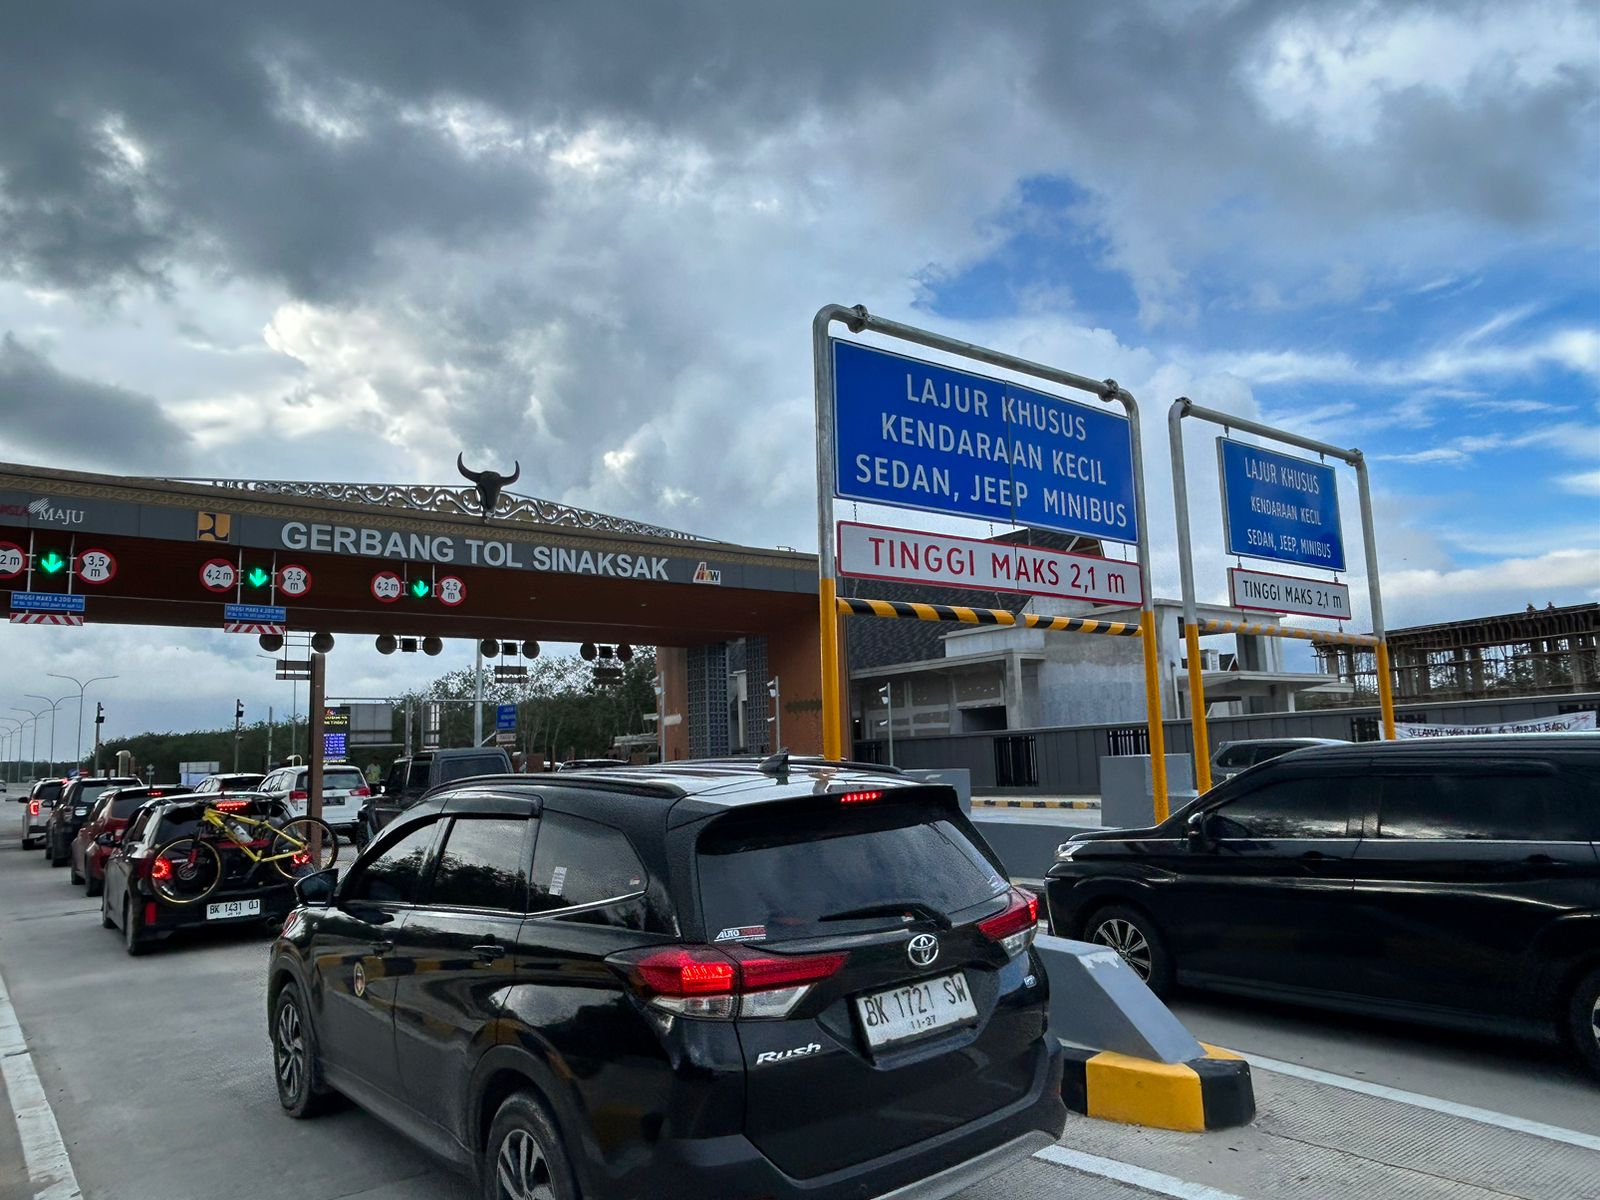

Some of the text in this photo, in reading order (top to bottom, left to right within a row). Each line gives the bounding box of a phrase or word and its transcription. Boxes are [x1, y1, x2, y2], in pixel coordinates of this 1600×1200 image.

[906, 373, 1086, 441] LAJUR KHUSUS
[881, 412, 1107, 485] KENDARAAN KECIL
[1245, 457, 1319, 495] LAJUR KHUSUS
[856, 454, 1127, 527] SEDAN, JEEP MINIBUS
[38, 508, 84, 525] MAJU
[1251, 496, 1322, 525] KENDARAAN KECIL
[281, 522, 669, 582] GERBANG TOL SINAKSAK
[1248, 528, 1277, 551] SEDAN,
[1301, 538, 1331, 558] MINIBUS
[10, 557, 19, 565] m
[88, 556, 105, 567] 3,5
[868, 536, 1125, 594] TINGGI MAKS 2,1 m
[206, 570, 231, 580] 4,2 m
[287, 571, 302, 581] 2,5
[290, 582, 298, 590] m
[1243, 580, 1342, 608] TINGGI MAKS 2,1 m
[1545, 721, 1570, 731] BARU
[210, 904, 220, 914] BK
[225, 902, 242, 912] 1431
[716, 929, 740, 939] AUTO
[864, 976, 967, 1027] BK 1721 SW
[911, 1015, 936, 1030] 11-27
[756, 1042, 821, 1065] Rush
